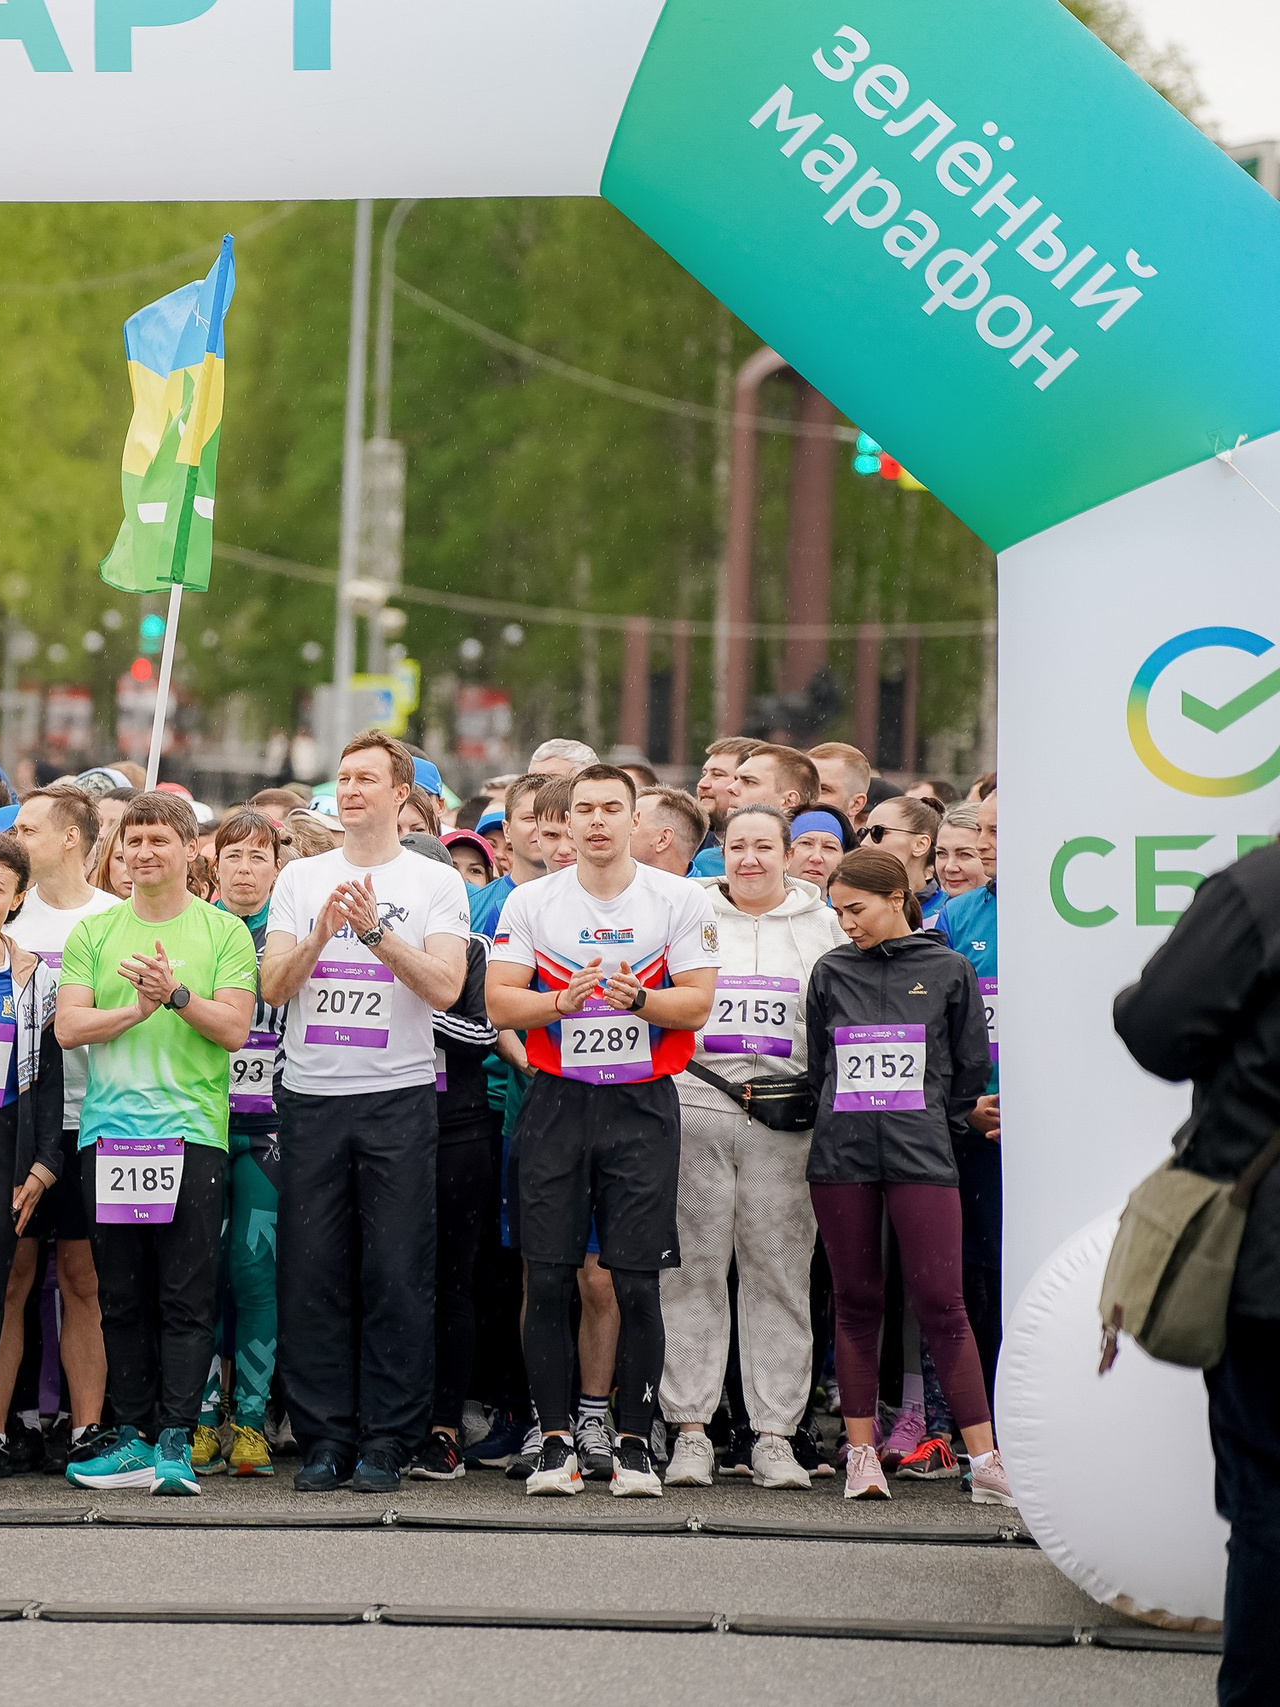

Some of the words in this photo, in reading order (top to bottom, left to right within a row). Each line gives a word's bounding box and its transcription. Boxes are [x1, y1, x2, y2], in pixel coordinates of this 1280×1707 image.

[812, 25, 1158, 332] зелёный
[748, 84, 1079, 391] марафон
[1049, 835, 1277, 928] СБ
[316, 989, 382, 1016] 2072
[718, 999, 787, 1026] 2153
[572, 1026, 640, 1054] 2289
[233, 1060, 264, 1082] 93
[847, 1054, 916, 1080] 2152
[110, 1167, 174, 1192] 2185
